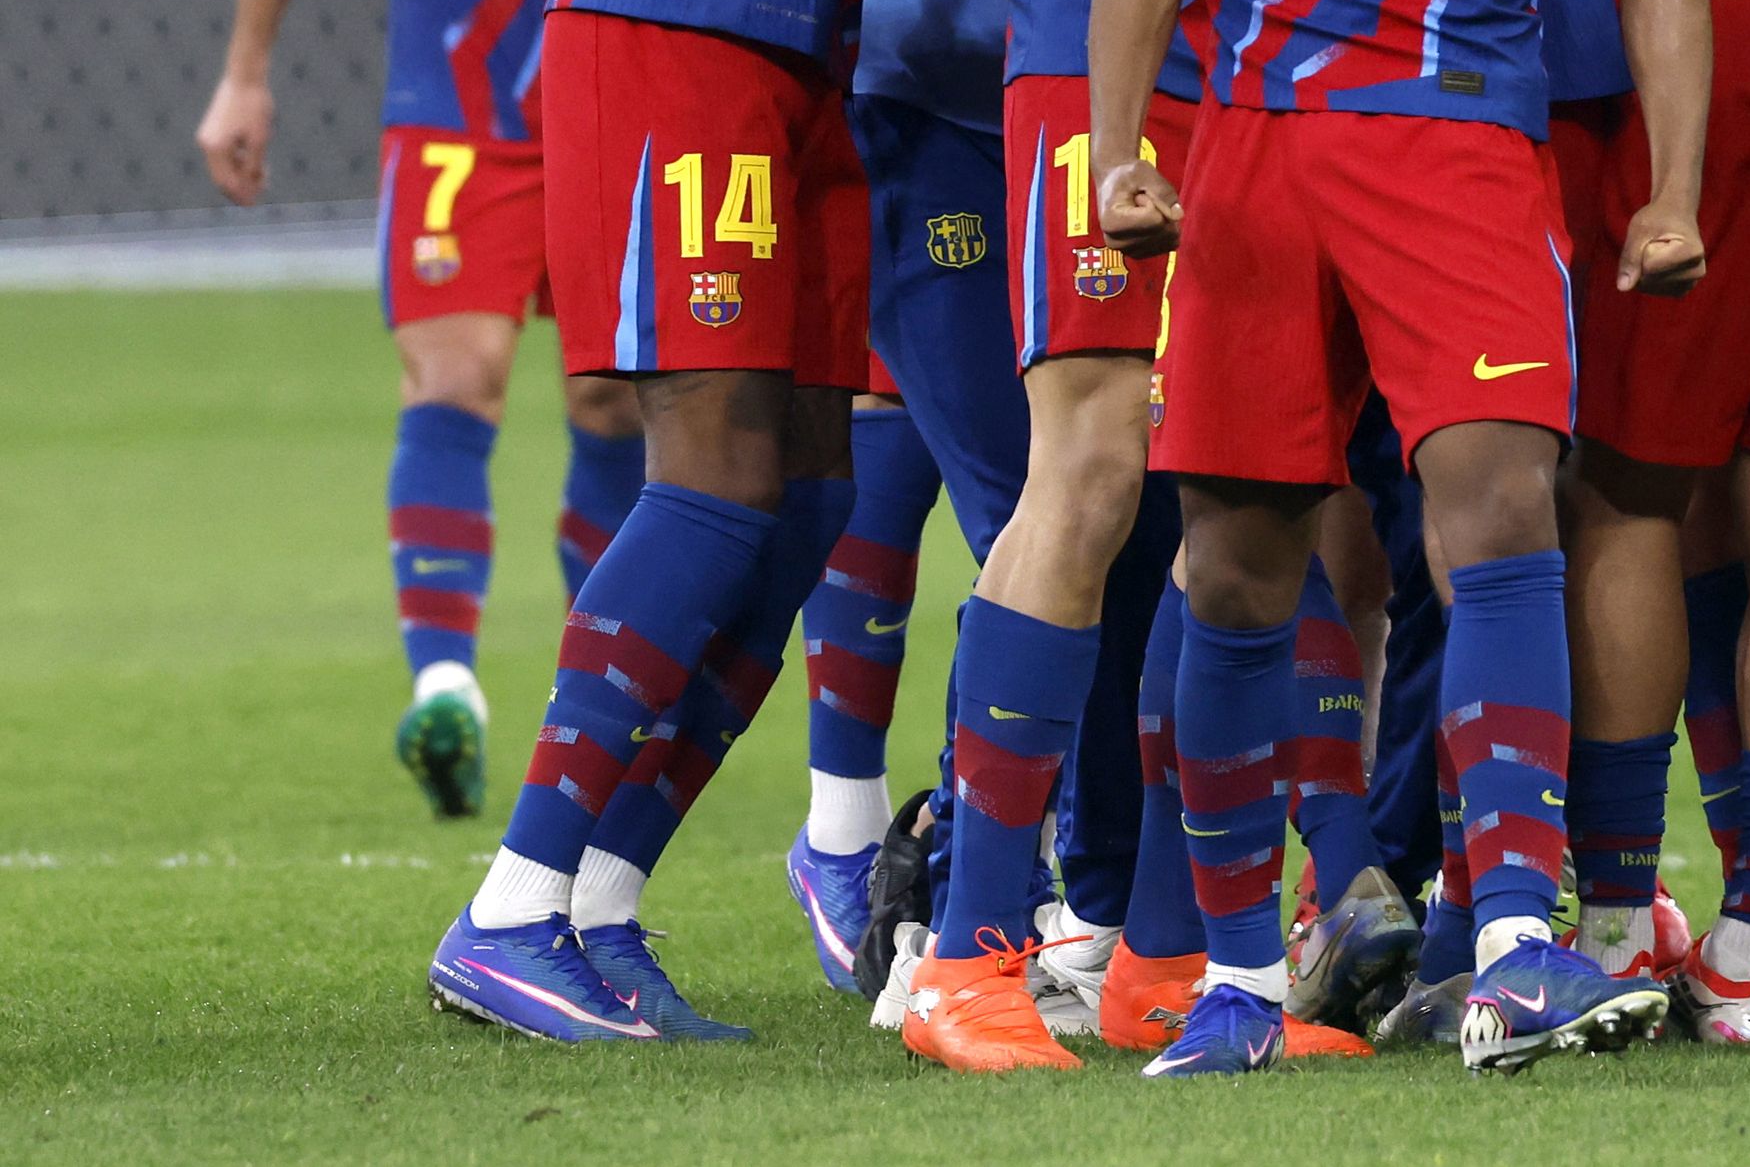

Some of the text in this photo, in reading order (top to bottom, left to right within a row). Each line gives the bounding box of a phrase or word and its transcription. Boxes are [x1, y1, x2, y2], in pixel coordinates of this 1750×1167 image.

[422, 142, 476, 231] 7
[664, 153, 777, 259] 14
[704, 295, 726, 303] FCB
